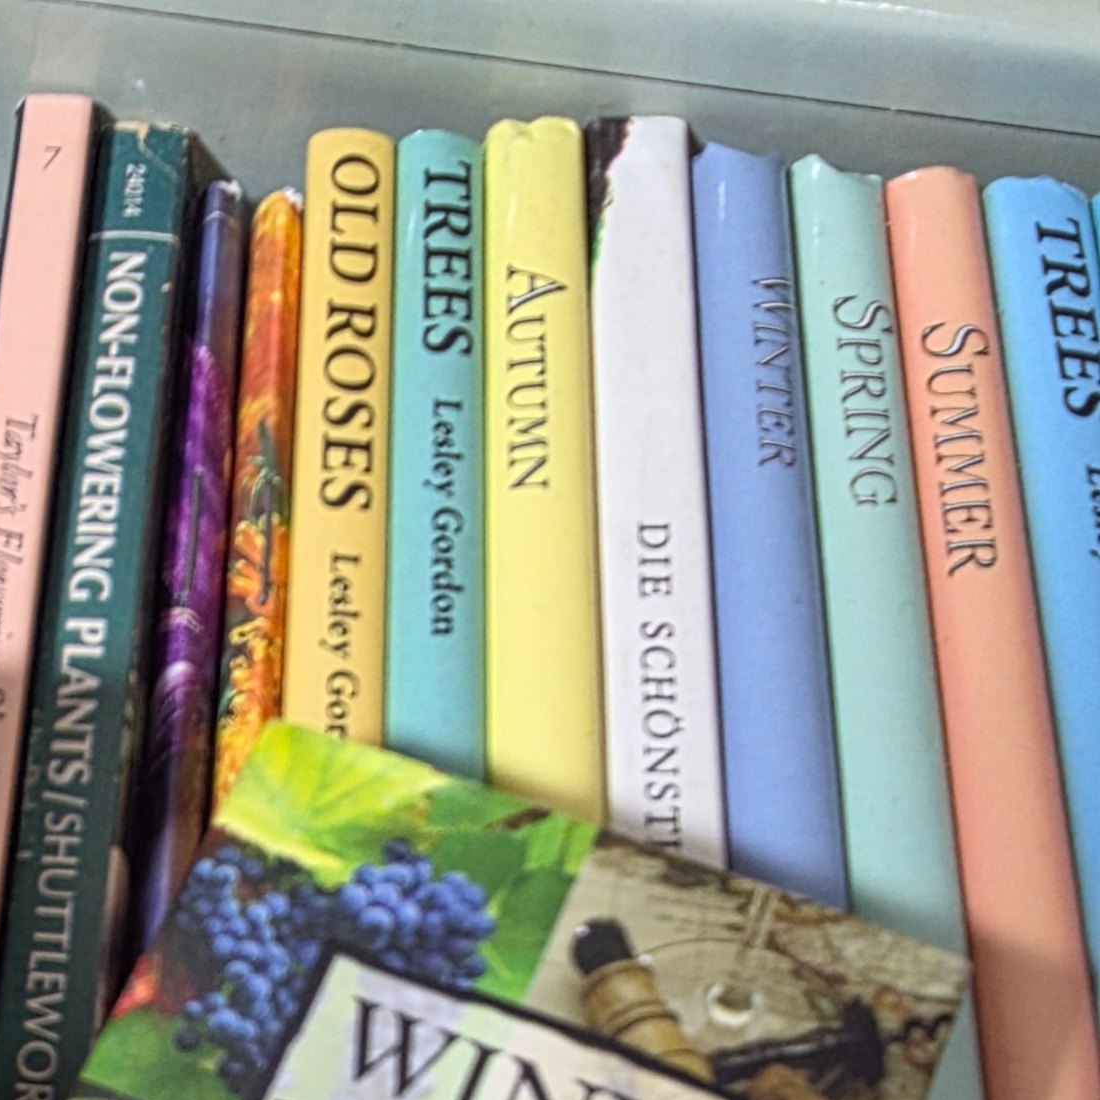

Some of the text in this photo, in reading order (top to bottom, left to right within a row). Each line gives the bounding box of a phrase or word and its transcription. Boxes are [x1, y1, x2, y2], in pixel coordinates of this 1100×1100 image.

[329, 153, 382, 285] OLD
[1034, 216, 1100, 420] TREES
[68, 251, 148, 603] NON-FLOWERING
[318, 297, 378, 512] ROSES
[420, 159, 475, 638] TREES Lesley Gordon
[318, 550, 364, 662] Lesley
[637, 521, 673, 599] DIE
